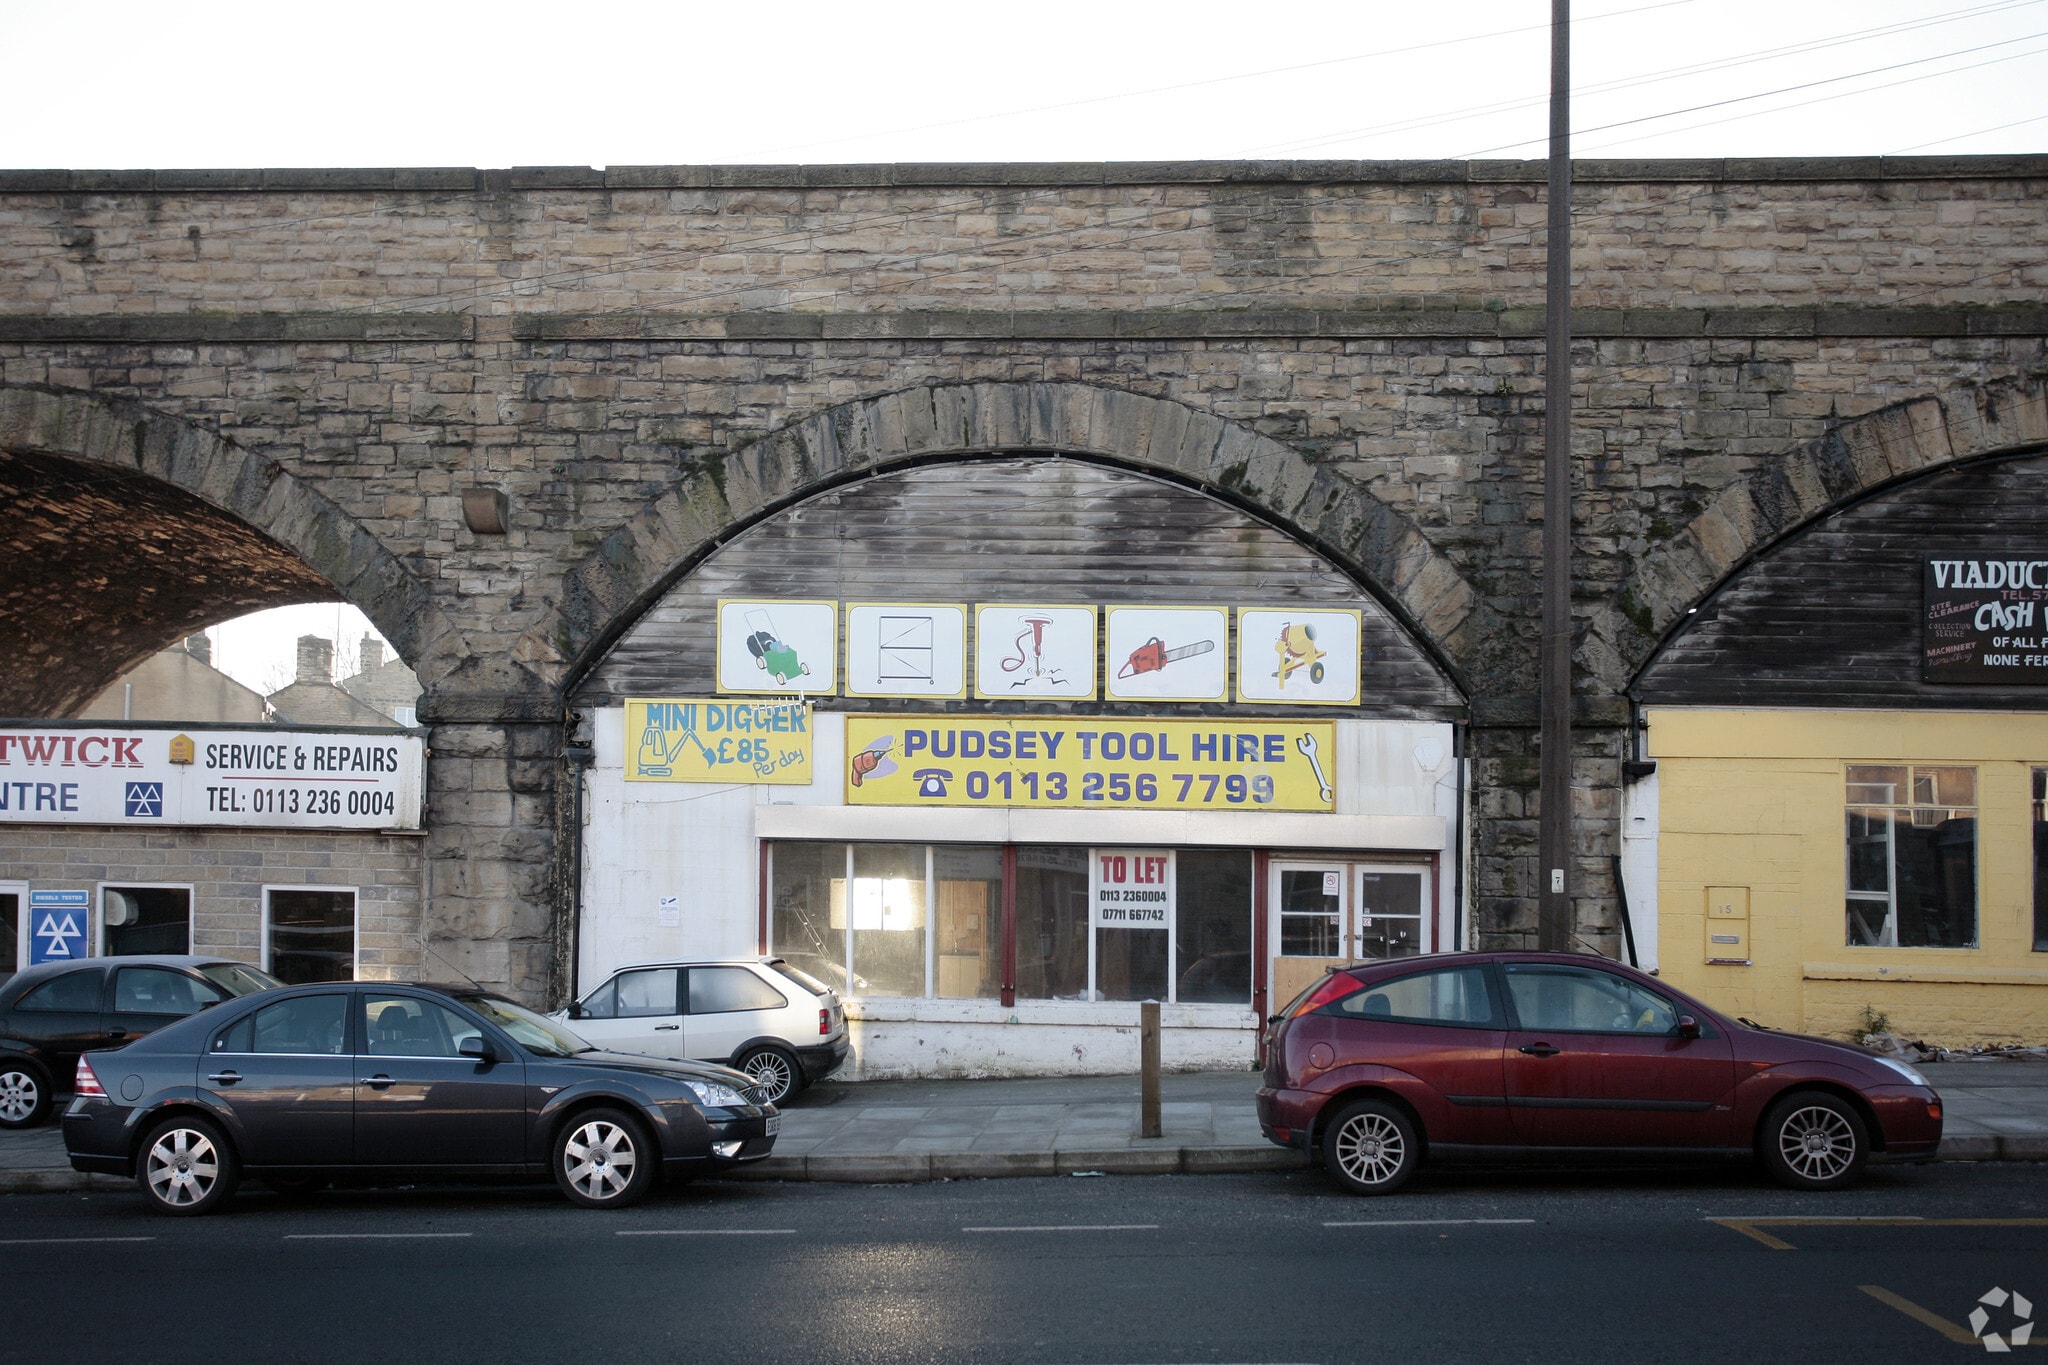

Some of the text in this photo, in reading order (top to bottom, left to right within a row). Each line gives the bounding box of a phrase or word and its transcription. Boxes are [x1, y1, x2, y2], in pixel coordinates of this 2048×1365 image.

[1928, 600, 1980, 619] CLEARANCE
[1931, 600, 1951, 611] SITE
[1974, 600, 2034, 631] CASH
[1935, 630, 1965, 638] SERVICE
[1993, 636, 2010, 648] OF
[2012, 636, 2038, 648] ALL
[1927, 641, 1976, 657] MACHINERY
[1983, 654, 2020, 666] NONE
[646, 703, 807, 733] MINI DIGGER
[717, 737, 770, 764] £85
[904, 729, 1285, 763] PUDSEY TOOL HIRE
[206, 743, 287, 770] SERVICE
[293, 745, 307, 771] &
[314, 746, 398, 773] REPAIRS
[779, 748, 805, 768] day
[966, 770, 1274, 804] 0113 256 7799
[206, 786, 395, 816] TEL: 0113 236 0004
[1100, 856, 1167, 884] TO LET
[1100, 890, 1167, 902] 0113 2360004
[1102, 908, 1164, 921] 07711 667742
